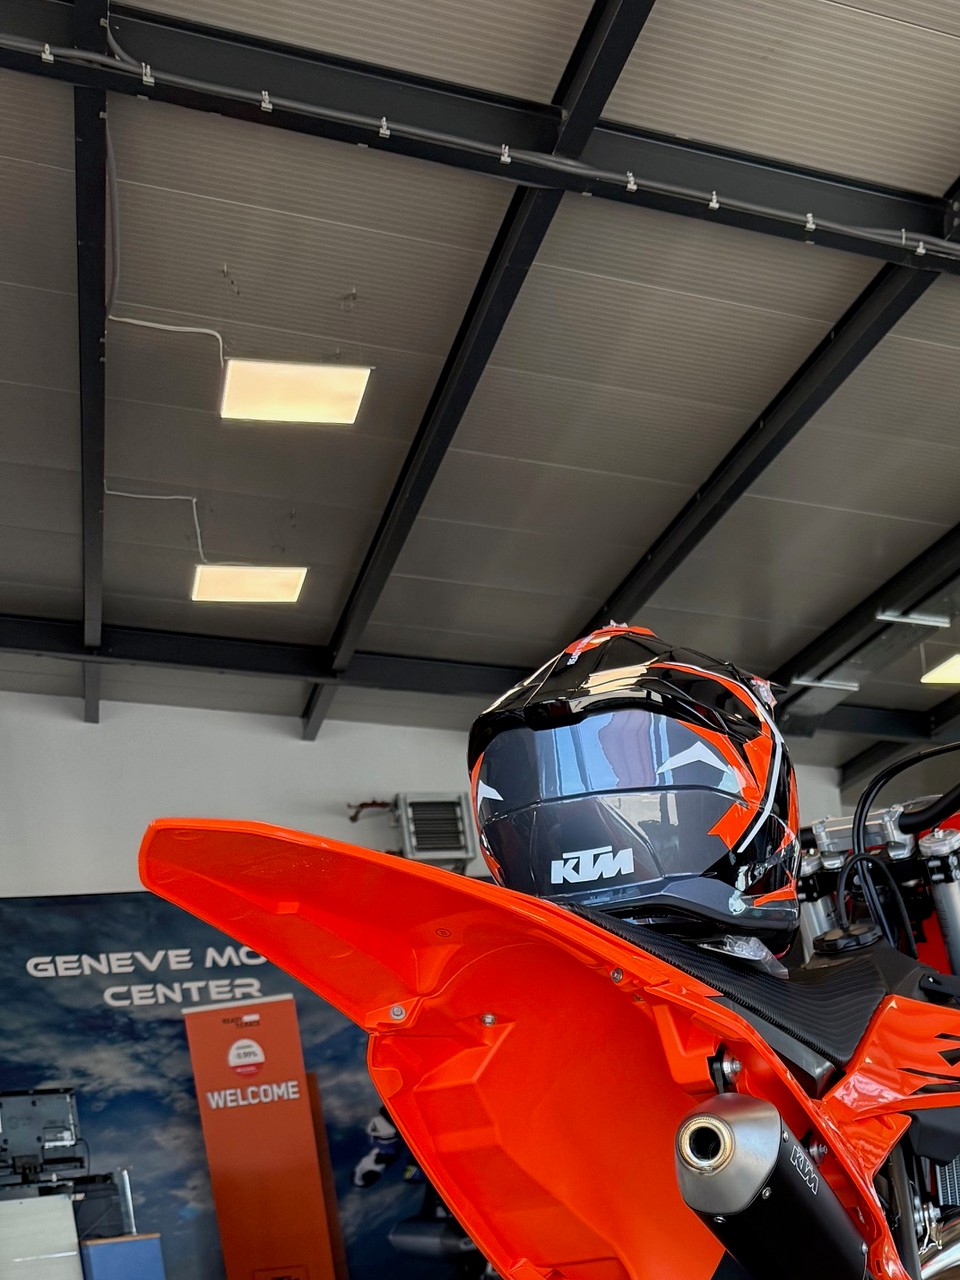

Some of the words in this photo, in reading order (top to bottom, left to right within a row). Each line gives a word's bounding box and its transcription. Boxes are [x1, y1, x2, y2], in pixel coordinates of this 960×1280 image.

[551, 845, 635, 884] KTM
[26, 949, 193, 978] GENEVE
[103, 977, 263, 1007] CENTER
[207, 1080, 300, 1109] WELCOME
[790, 1145, 819, 1195] KTM
